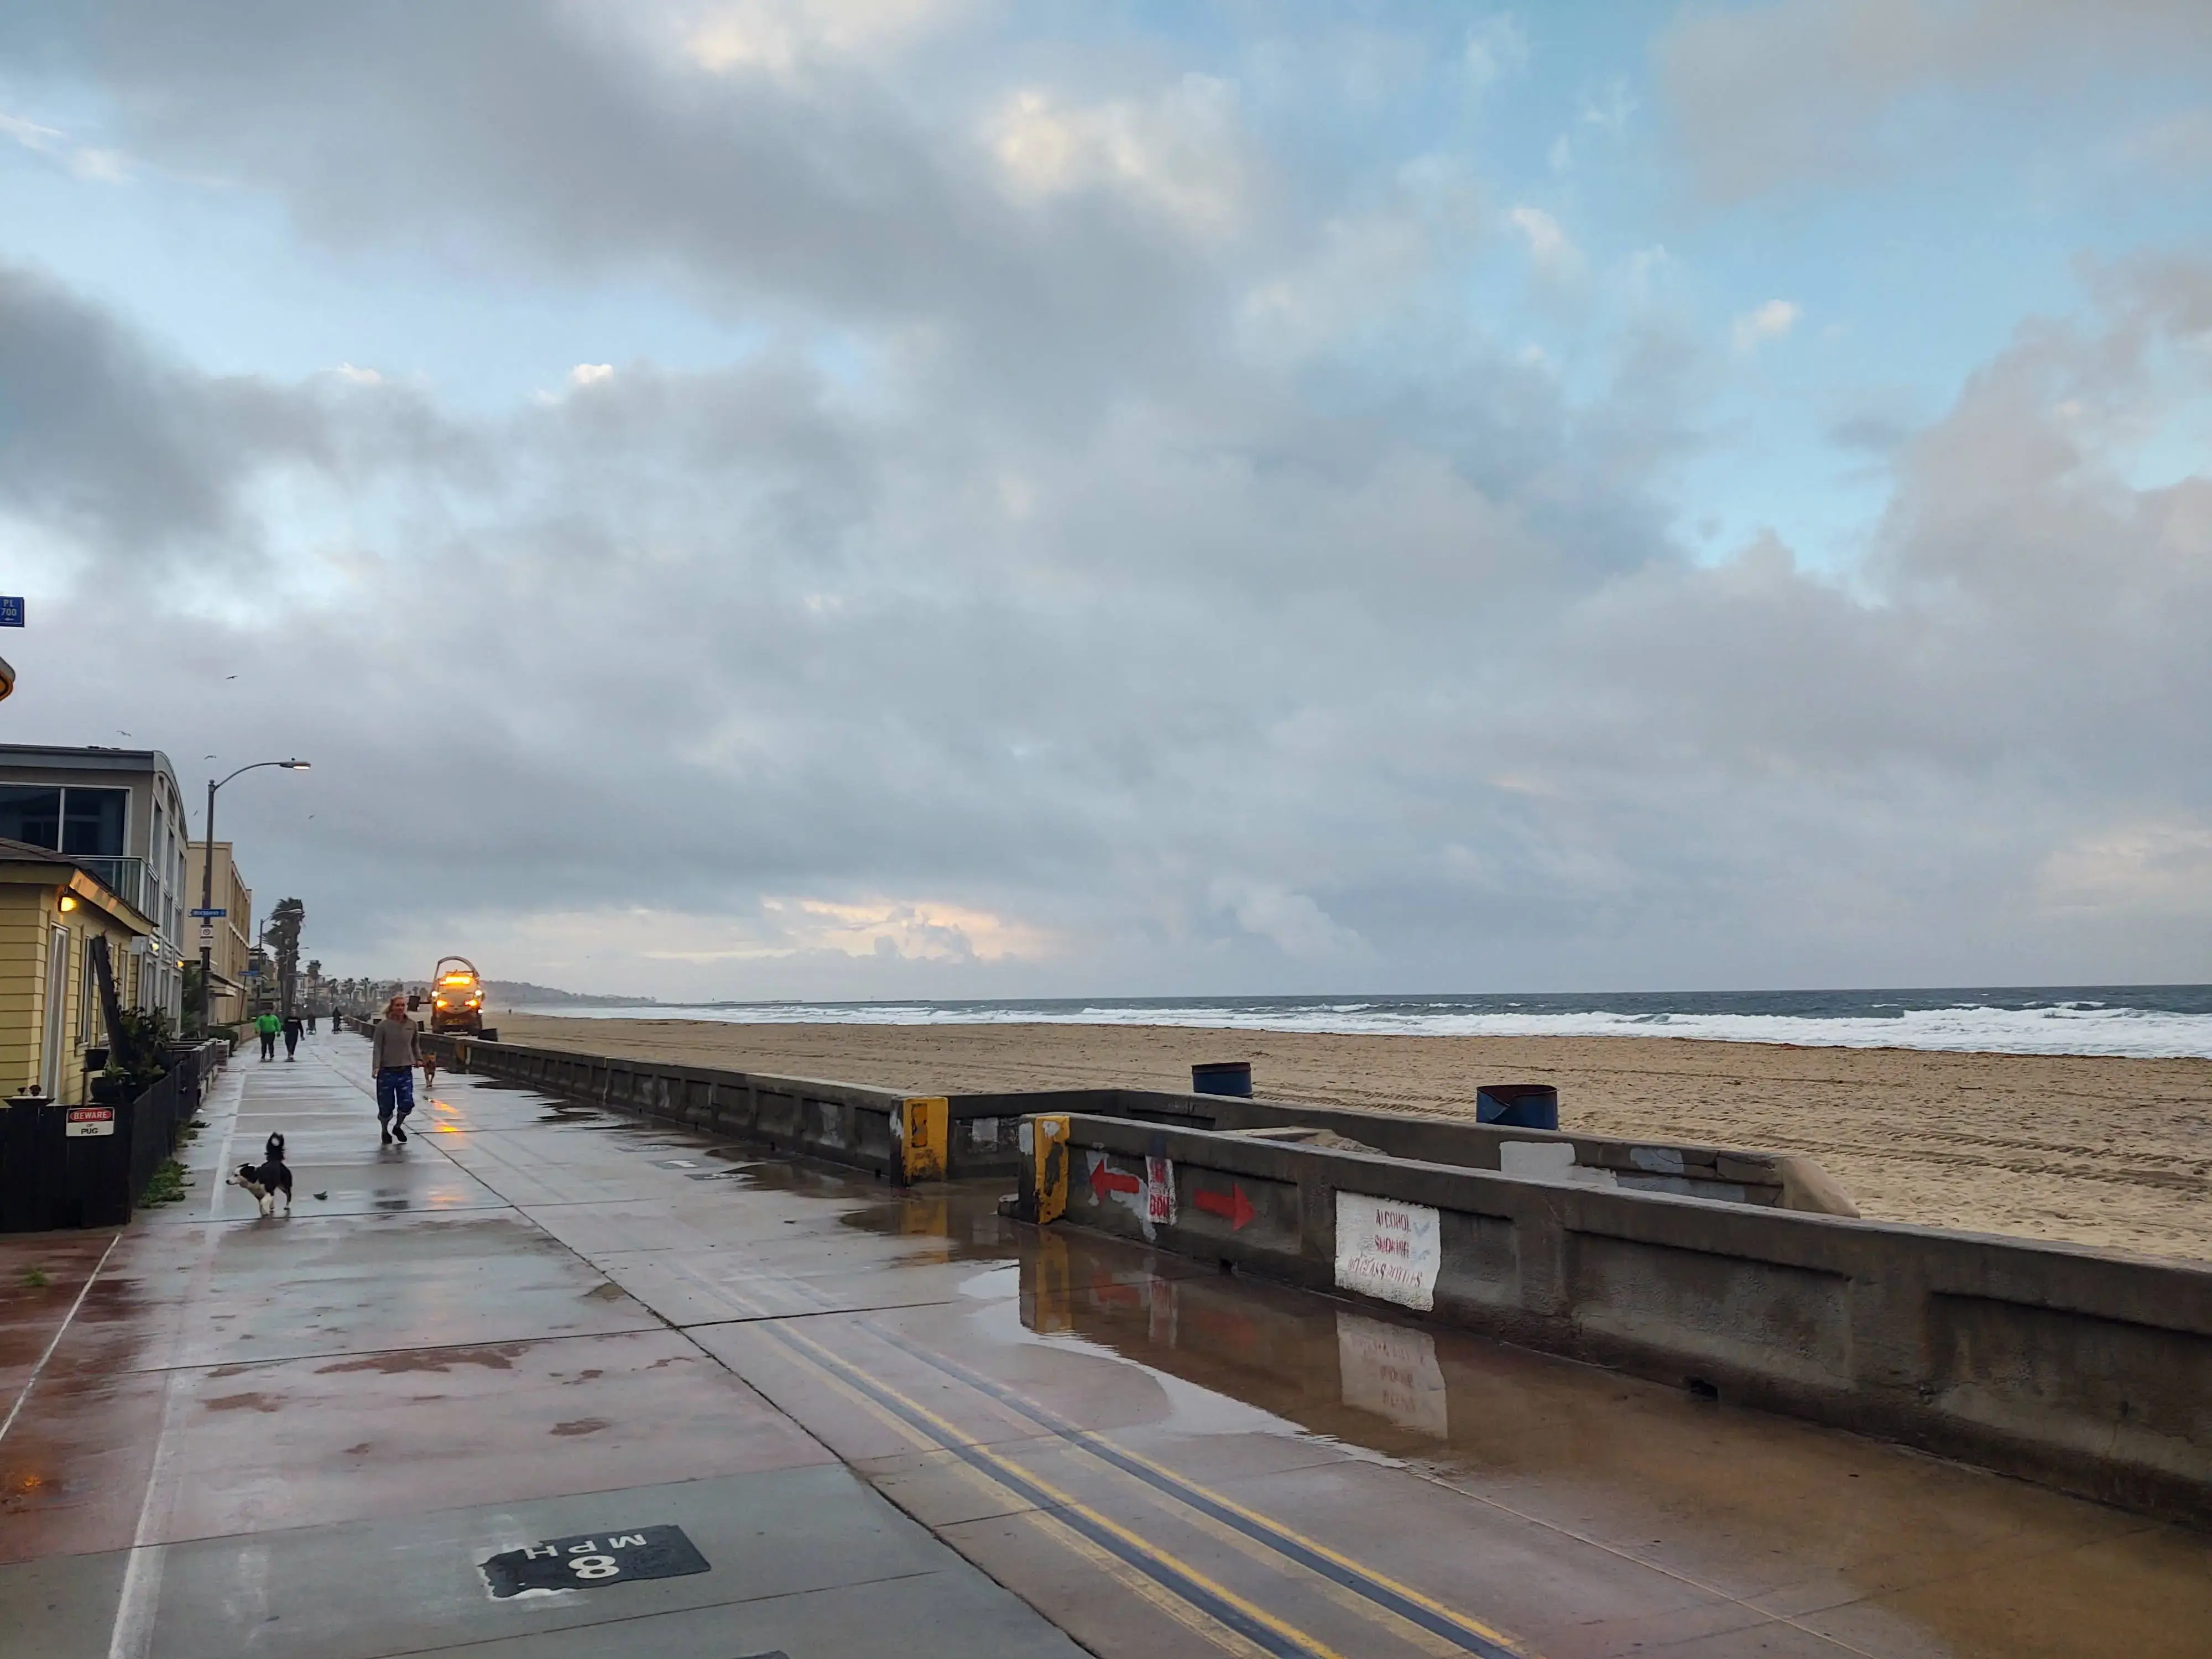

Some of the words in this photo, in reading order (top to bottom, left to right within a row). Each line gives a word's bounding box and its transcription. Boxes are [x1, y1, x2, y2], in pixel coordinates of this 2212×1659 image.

[1, 608, 17, 616] 700
[74, 1111, 107, 1120] BEWARE
[1376, 1209, 1411, 1234] ALCOHOL
[1375, 1234, 1410, 1259] SMOKING
[526, 1534, 647, 1559] MPH
[568, 1555, 620, 1579] 8
